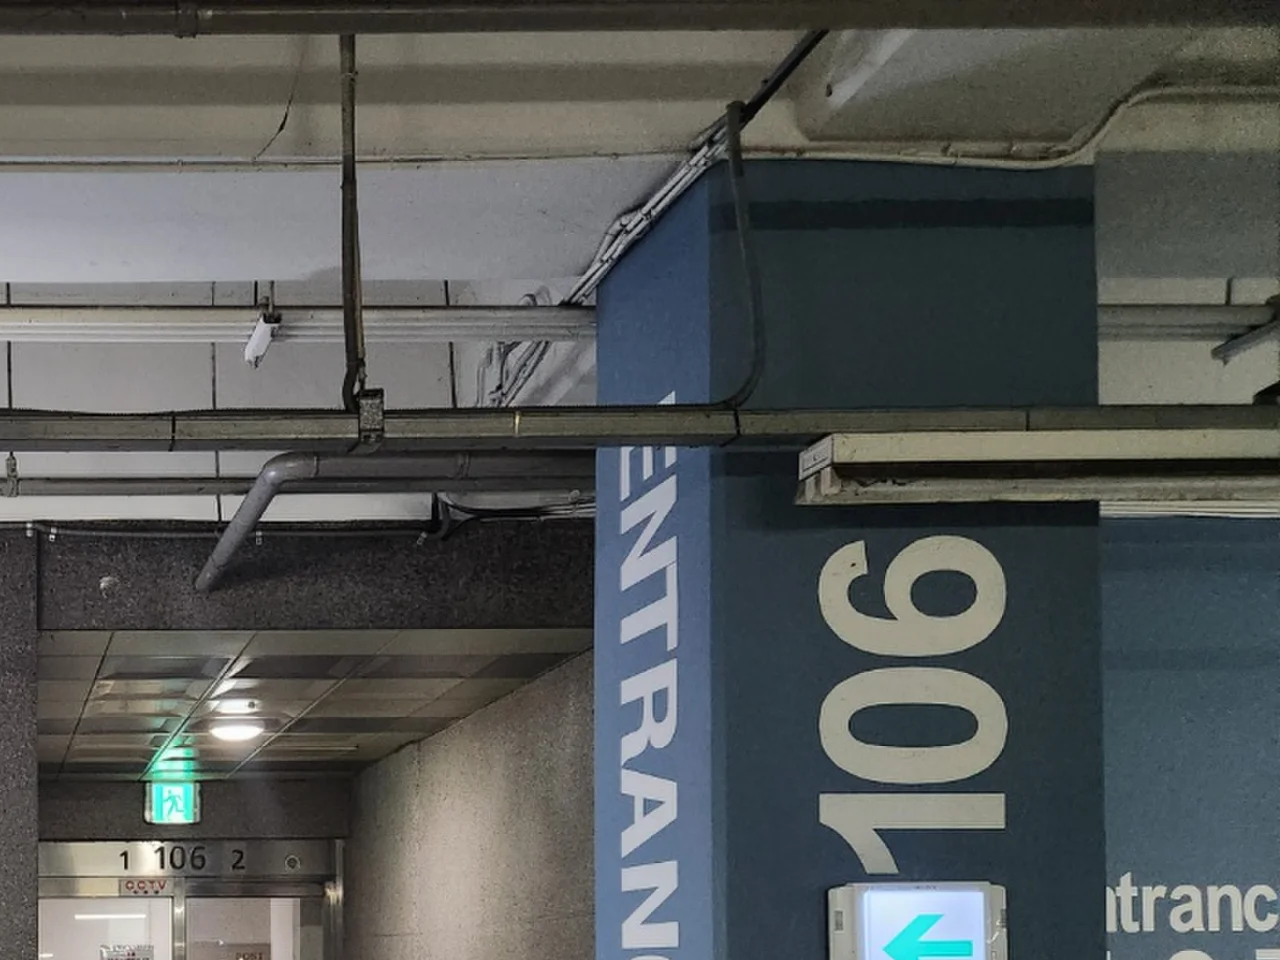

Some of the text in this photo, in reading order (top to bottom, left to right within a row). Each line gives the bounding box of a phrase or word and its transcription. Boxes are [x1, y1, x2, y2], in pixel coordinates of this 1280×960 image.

[819, 534, 1008, 875] 106
[119, 846, 246, 870] 1 106 2
[125, 880, 167, 890] CCTV
